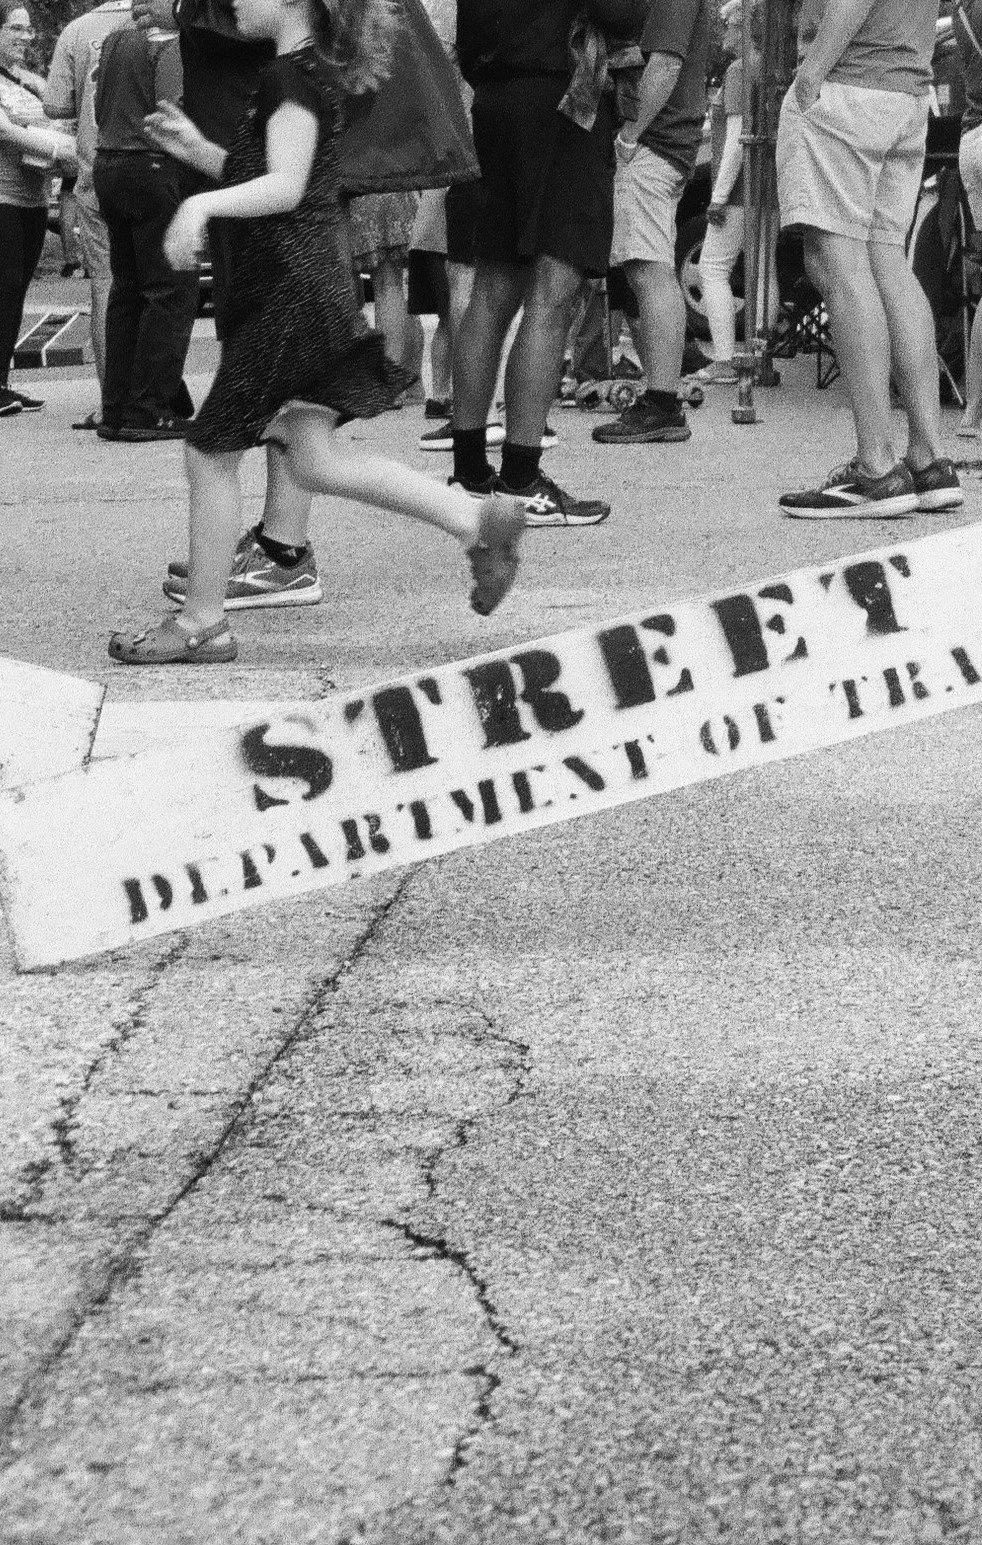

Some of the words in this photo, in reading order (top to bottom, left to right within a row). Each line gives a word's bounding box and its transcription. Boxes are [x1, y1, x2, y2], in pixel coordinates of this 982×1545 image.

[238, 553, 913, 812] STREET
[122, 734, 659, 924] DEPARTMENT
[699, 695, 785, 756] OF
